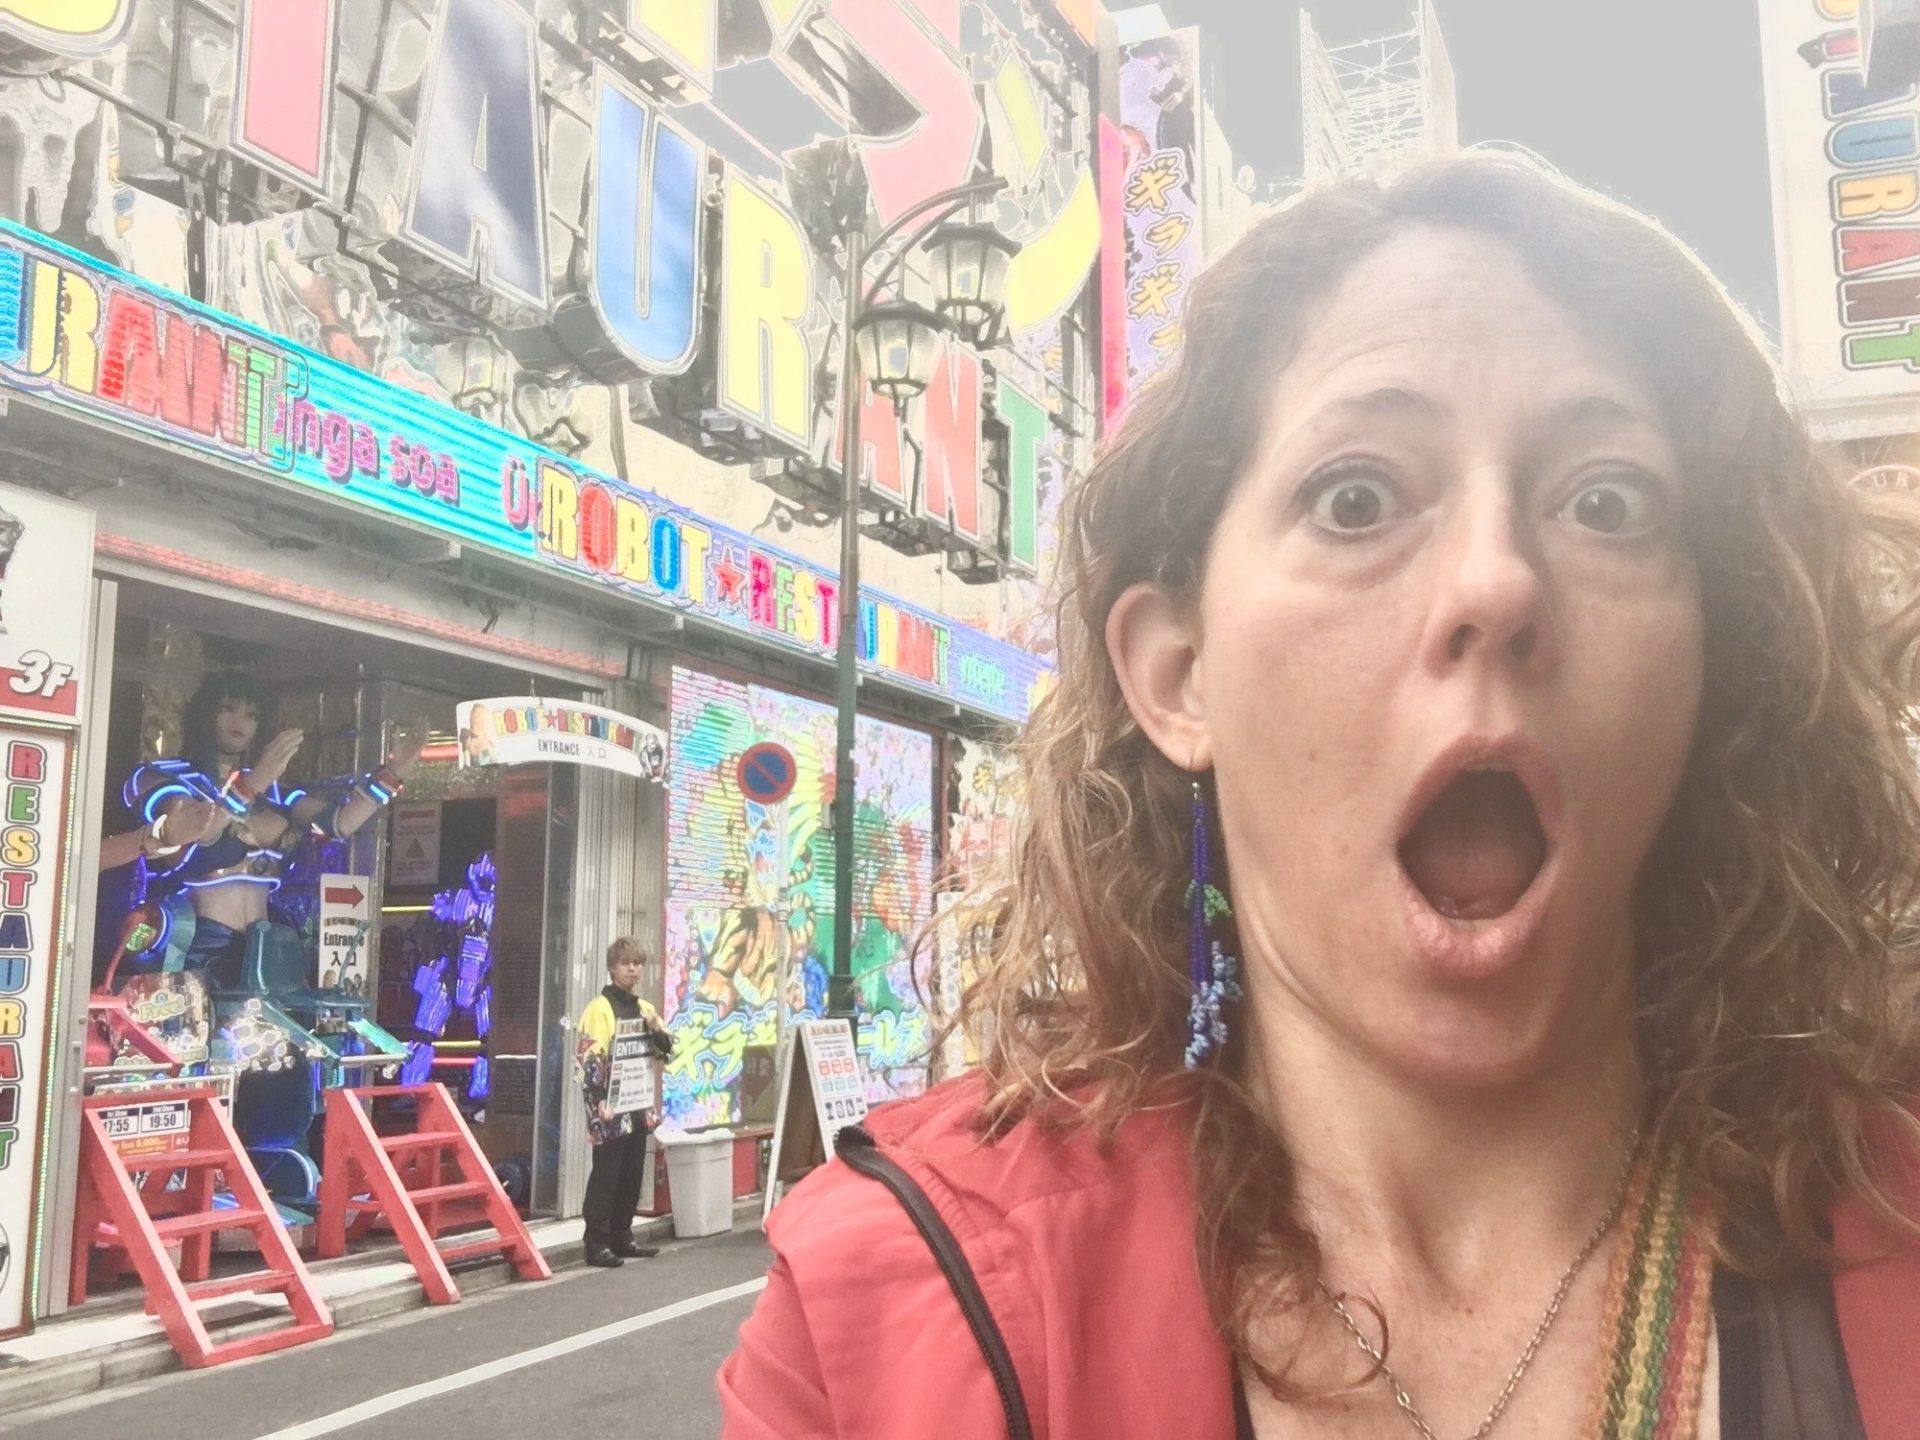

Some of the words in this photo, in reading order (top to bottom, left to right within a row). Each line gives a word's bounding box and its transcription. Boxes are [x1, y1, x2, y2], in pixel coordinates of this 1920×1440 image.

[389, 433, 462, 509] soa
[540, 462, 712, 606] ROBOT
[744, 546, 950, 690] RESTURANT
[9, 650, 74, 698] 3F
[493, 705, 545, 736] ROBOT
[538, 738, 581, 757] ENTRANCE
[149, 1114, 177, 1129] 19:50
